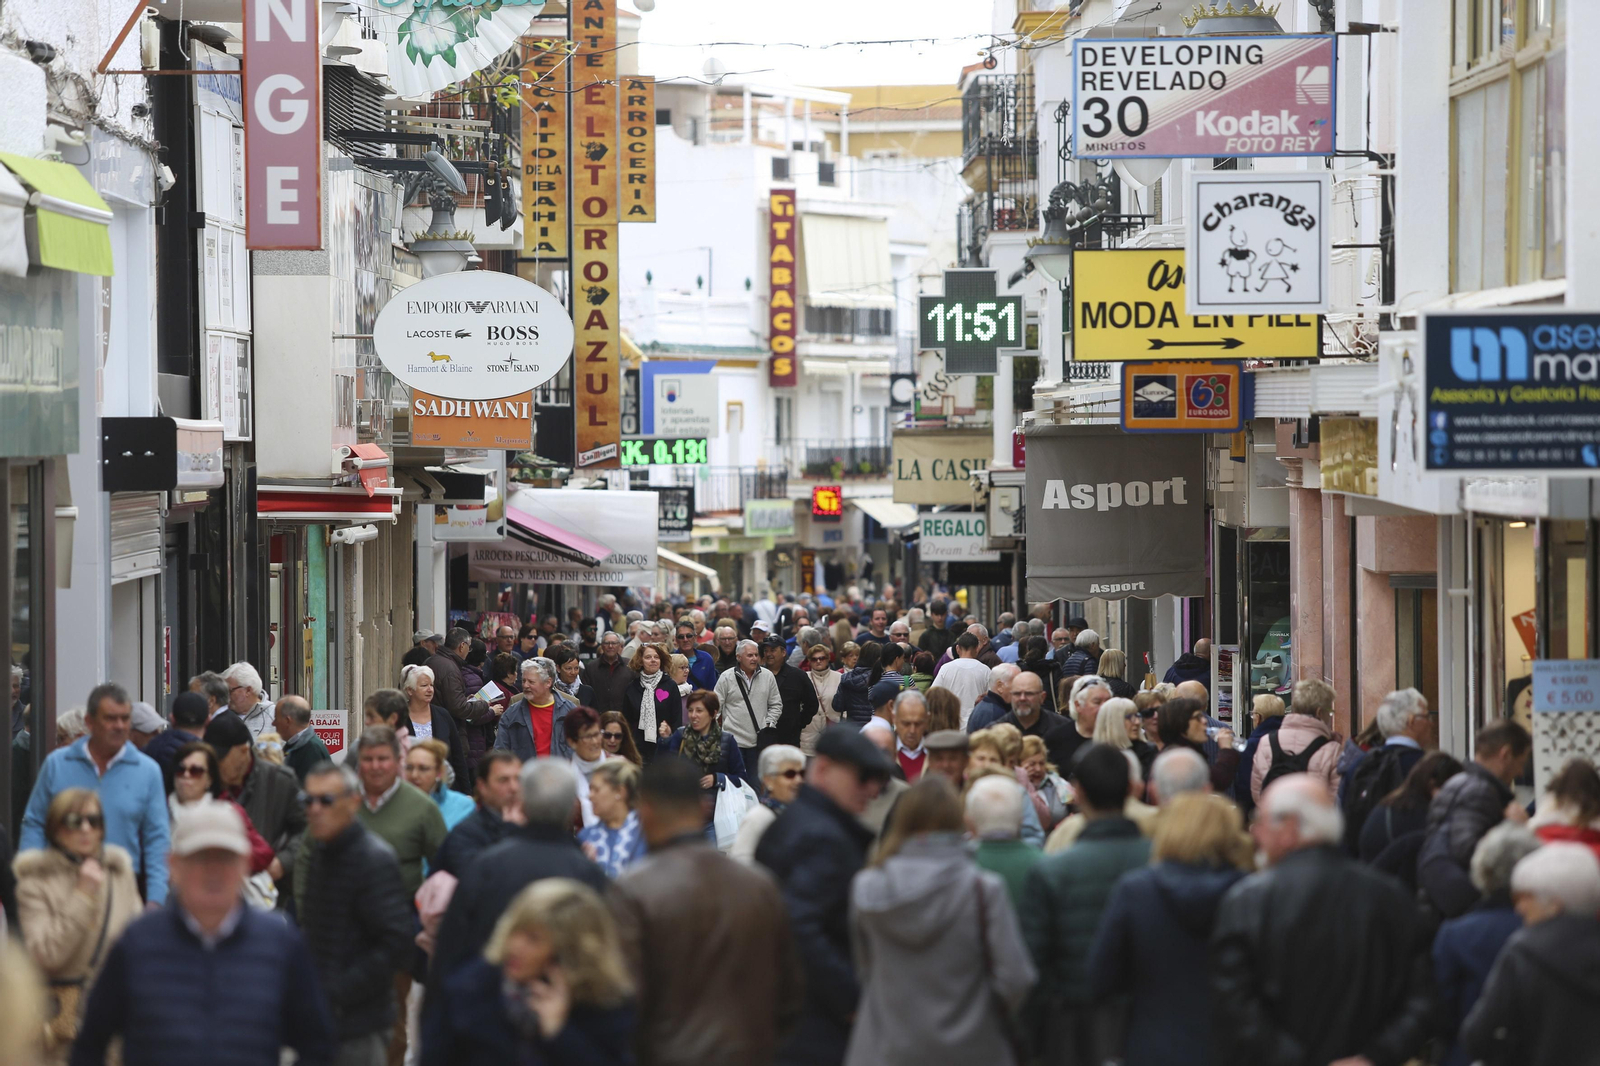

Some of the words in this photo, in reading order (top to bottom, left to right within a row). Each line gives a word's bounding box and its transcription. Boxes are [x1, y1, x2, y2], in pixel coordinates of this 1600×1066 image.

[1081, 45, 1263, 67] DEVELOPING
[1081, 70, 1227, 91] REVELADO
[585, 84, 605, 137] EL
[1082, 96, 1149, 138] 30
[1196, 110, 1300, 137] Kodak
[627, 81, 648, 215] ARROCERIA
[1086, 141, 1146, 151] MINUTOS
[1225, 137, 1276, 152] FOTO
[1281, 136, 1321, 151] REY
[526, 165, 542, 175] DE
[546, 165, 562, 175] LA
[532, 181, 557, 252] BAHIA
[1202, 192, 1316, 232] Charanga
[582, 164, 608, 282] TORO
[1147, 259, 1185, 291] Os
[407, 300, 468, 314] EMPORIO
[487, 300, 539, 314] ARMANI
[1081, 301, 1180, 329] MODA
[928, 302, 1015, 341] 11:51
[407, 330, 452, 338] LACOSTE
[487, 325, 539, 341] BOSS
[407, 363, 439, 373] Harmont
[440, 364, 448, 373] &
[450, 363, 473, 373] Blaine
[487, 364, 509, 373] STONE
[513, 364, 540, 373] ISLAND
[583, 309, 609, 426] AZUL
[1534, 353, 1600, 381] ma
[414, 399, 529, 419] SADHWANI
[897, 459, 922, 480] LA
[1041, 477, 1188, 512] Asport
[659, 519, 687, 529] SHOP
[473, 550, 512, 562] ARROCES
[515, 551, 559, 562] PESCADOS
[922, 541, 962, 556] Dream
[500, 569, 524, 580] RICES
[528, 570, 555, 580] MEATS
[560, 570, 578, 581] FISH
[1090, 581, 1145, 593] Asport
[1547, 691, 1556, 705] €
[1561, 690, 1594, 706] 5,00
[323, 731, 340, 739] OUR
